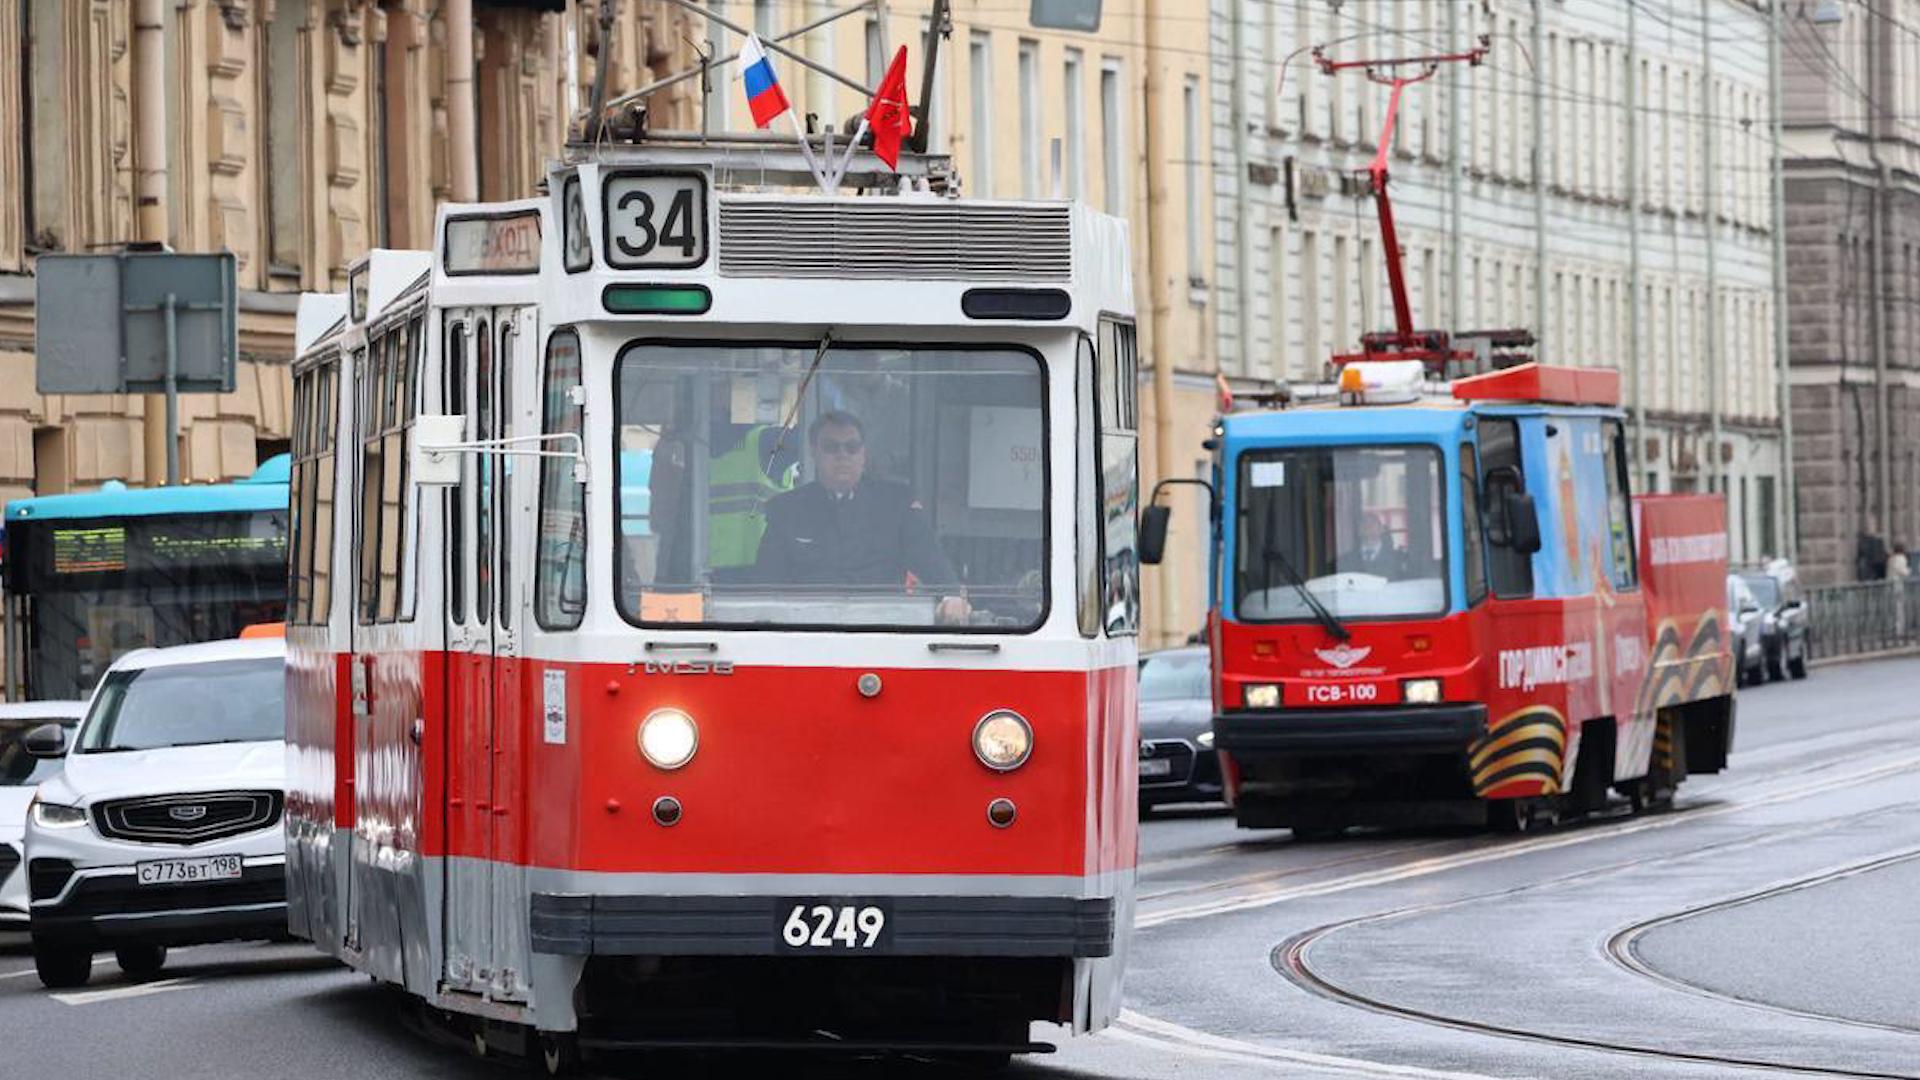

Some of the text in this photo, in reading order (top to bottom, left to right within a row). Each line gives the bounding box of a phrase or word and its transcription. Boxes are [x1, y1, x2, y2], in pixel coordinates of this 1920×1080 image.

[616, 189, 696, 257] 34
[1308, 683, 1377, 701] ГСВ-100
[212, 857, 238, 871] 198
[782, 904, 885, 948] 6249
